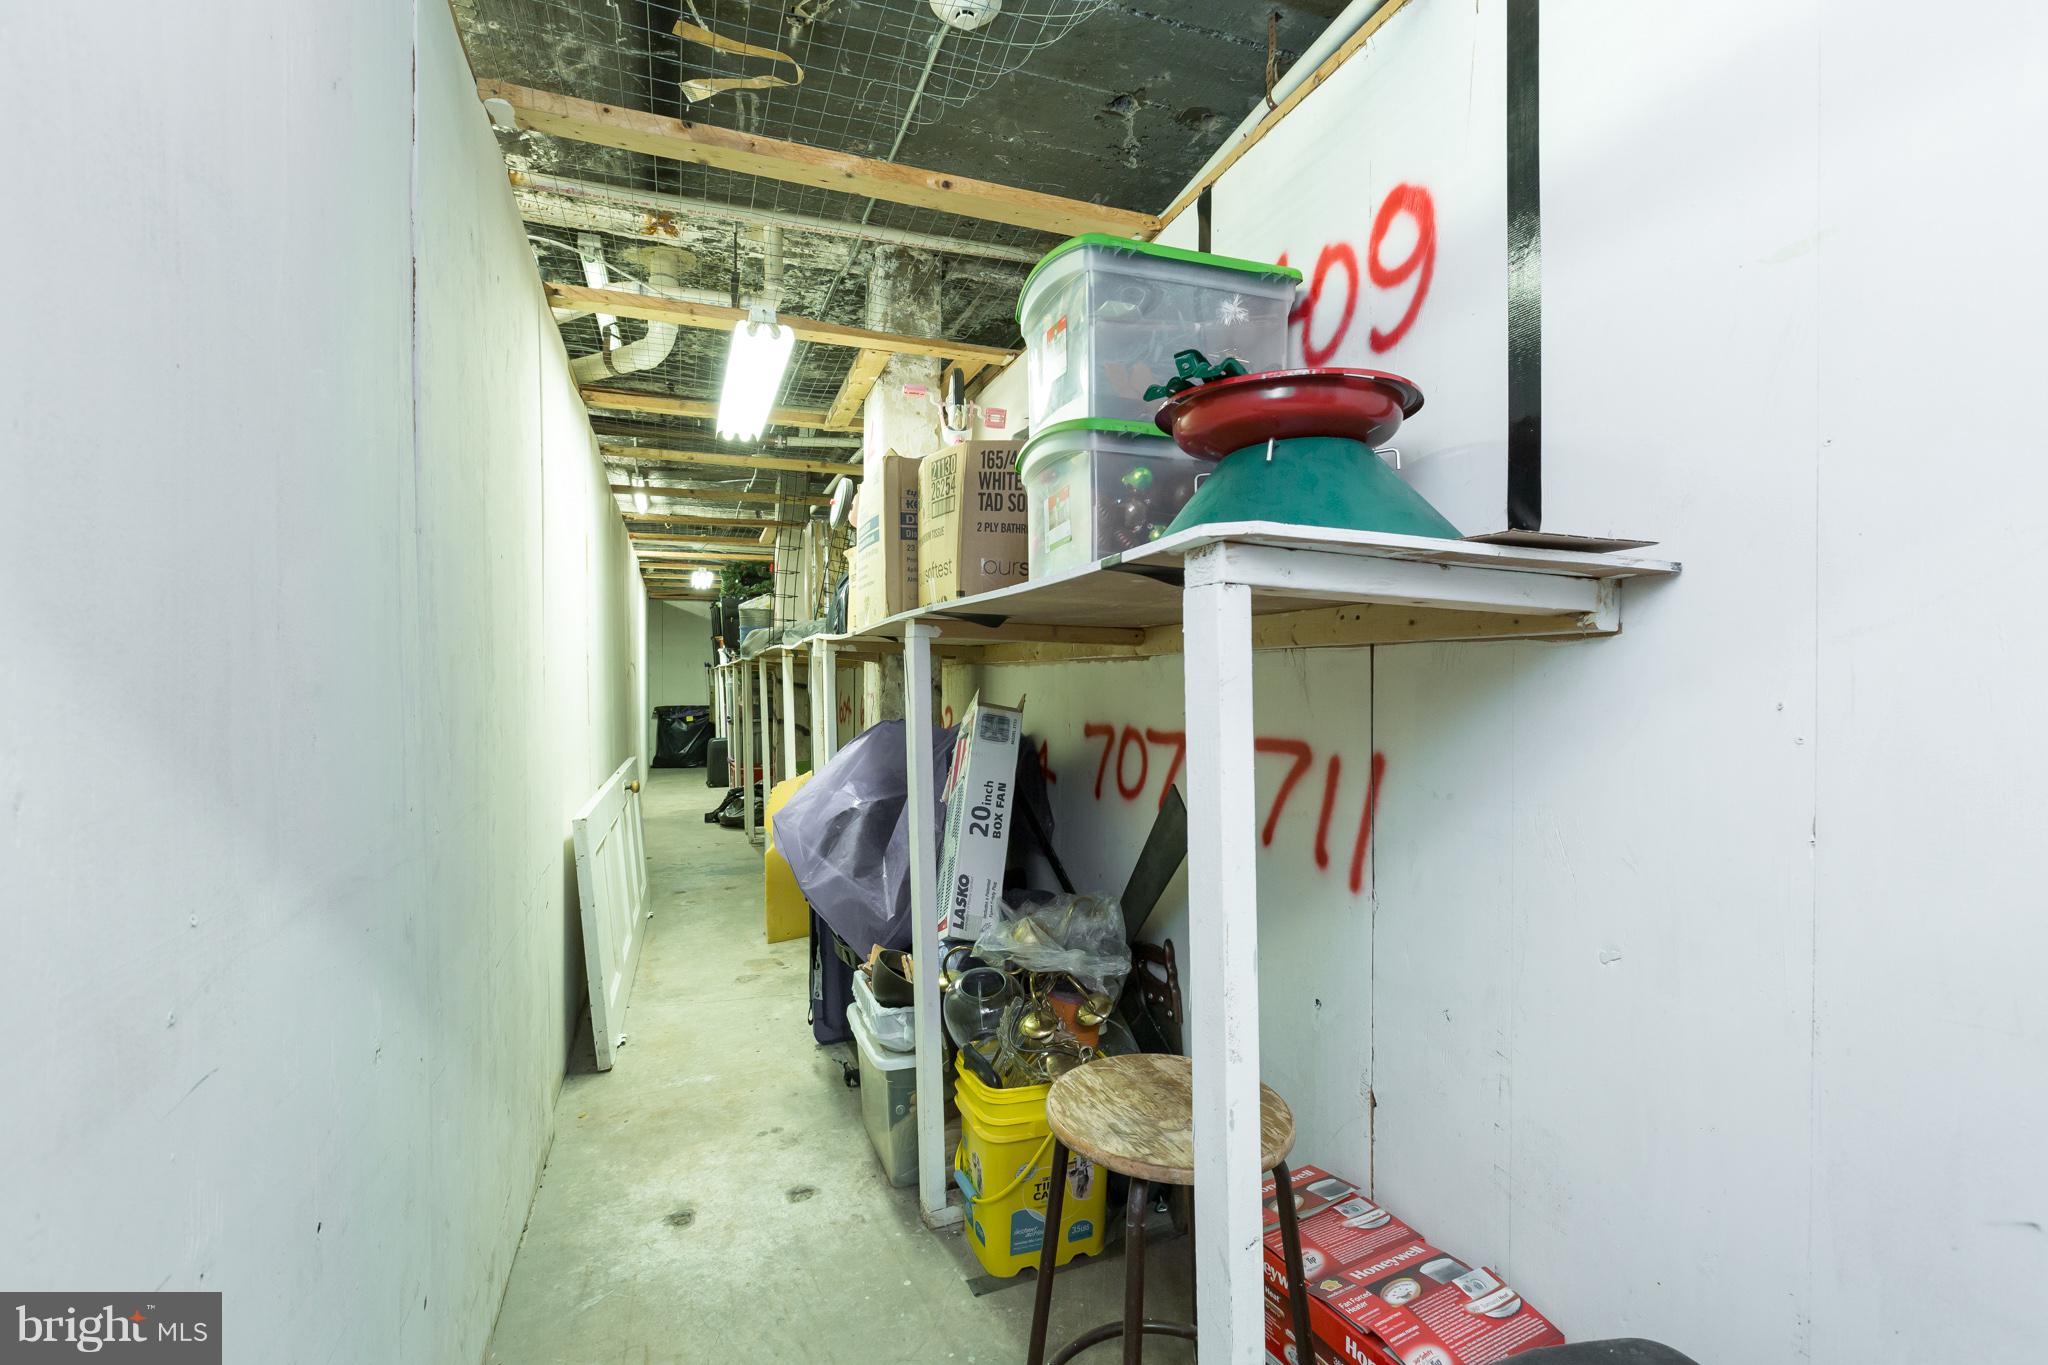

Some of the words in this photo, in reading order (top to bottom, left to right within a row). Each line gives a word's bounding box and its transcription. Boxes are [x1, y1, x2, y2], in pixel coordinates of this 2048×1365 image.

[1276, 182, 1437, 368] 09
[931, 475, 956, 501] 26254
[979, 472, 1021, 491] WHITE
[978, 493, 1003, 512] TAD
[1008, 494, 1028, 512] SO
[977, 522, 982, 532] 2
[985, 523, 998, 533] PLY
[1001, 523, 1028, 534] BATHR
[1084, 722, 1187, 812] 707
[996, 782, 1007, 809] FAN
[993, 812, 1004, 839] BOX
[1253, 736, 1386, 895] 711
[953, 873, 970, 930] LASKO
[1349, 1245, 1427, 1280] Honeywell
[1338, 1298, 1353, 1310] Fan
[1350, 1290, 1373, 1304] Forced
[1345, 1301, 1369, 1315] Heater
